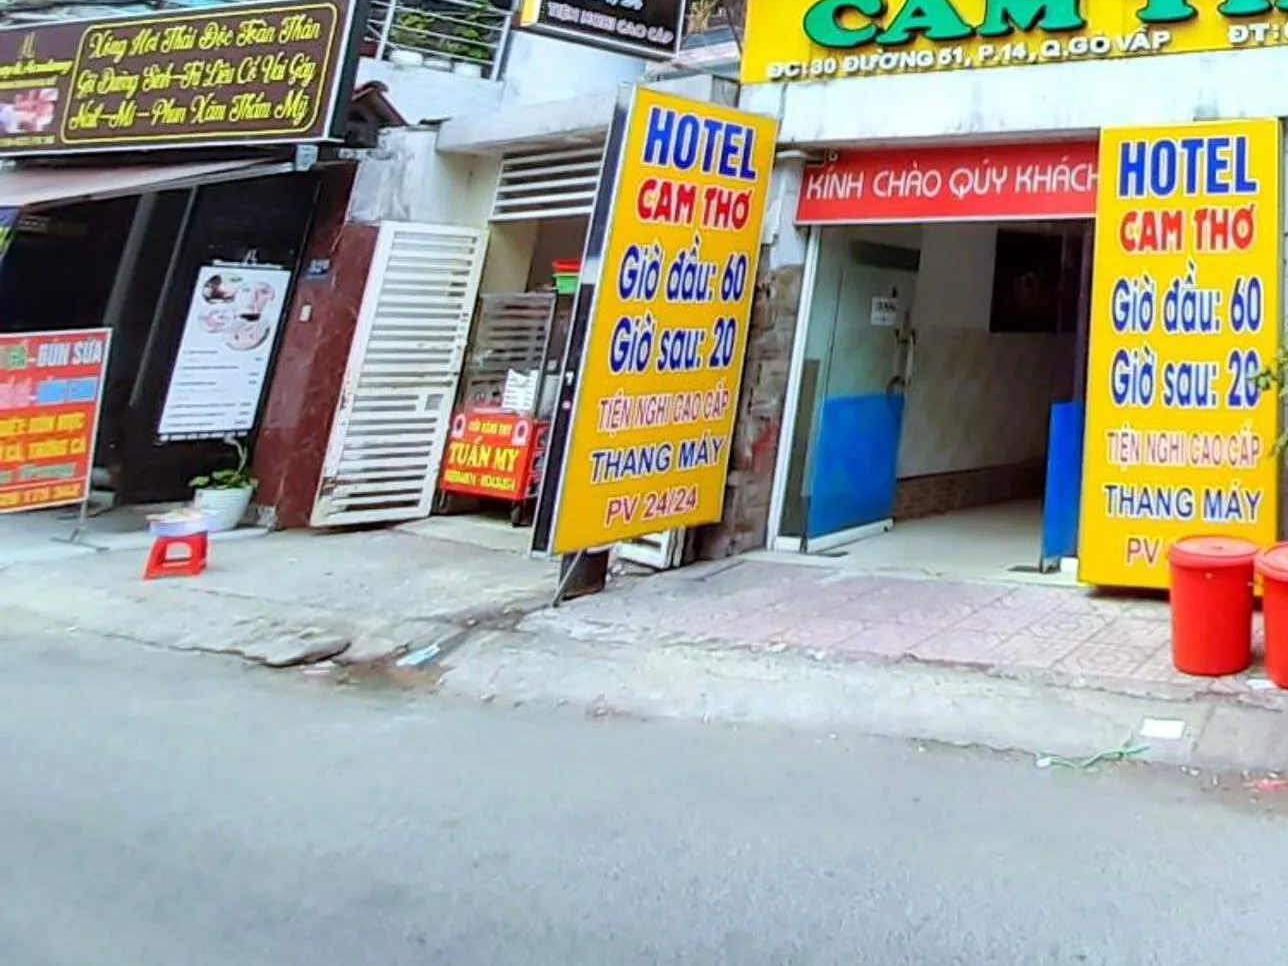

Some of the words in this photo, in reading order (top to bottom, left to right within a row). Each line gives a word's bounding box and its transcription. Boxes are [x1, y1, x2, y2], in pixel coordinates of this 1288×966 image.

[843, 49, 933, 72] ĐƯỜNG
[642, 106, 757, 180] HOTEL
[1118, 136, 1259, 198] HOTEL
[636, 178, 697, 223] CAM
[702, 188, 753, 231] THƠ
[806, 164, 864, 201] KÍNH
[873, 168, 942, 198] CHÀO
[1119, 209, 1183, 253] CAM
[1193, 203, 1256, 252] THƠ
[618, 242, 662, 300] Giờ
[666, 235, 717, 302] đầu:
[720, 252, 748, 302] 60
[1112, 274, 1155, 333] Giờ
[1163, 260, 1223, 333] đầu:
[1230, 276, 1263, 333] 60
[609, 313, 655, 372] Giờ
[657, 328, 706, 372] sau:
[709, 317, 737, 369] 20
[1111, 345, 1154, 406] Giờ
[1163, 361, 1219, 408] sau:
[1228, 349, 1260, 408] 20
[598, 390, 632, 437] TIỆN
[632, 392, 670, 429] NGHI
[673, 390, 701, 424] CAO
[590, 443, 673, 483] THANG
[677, 430, 725, 469] MÁY
[1107, 424, 1141, 472] TIỆN
[1147, 432, 1185, 465] NGHI
[1190, 433, 1224, 466] CAO
[605, 497, 639, 527] PV
[643, 486, 698, 521] 24/24
[1104, 484, 1194, 519] THANG
[1203, 480, 1262, 522] MÁY
[1125, 537, 1161, 566] PV
